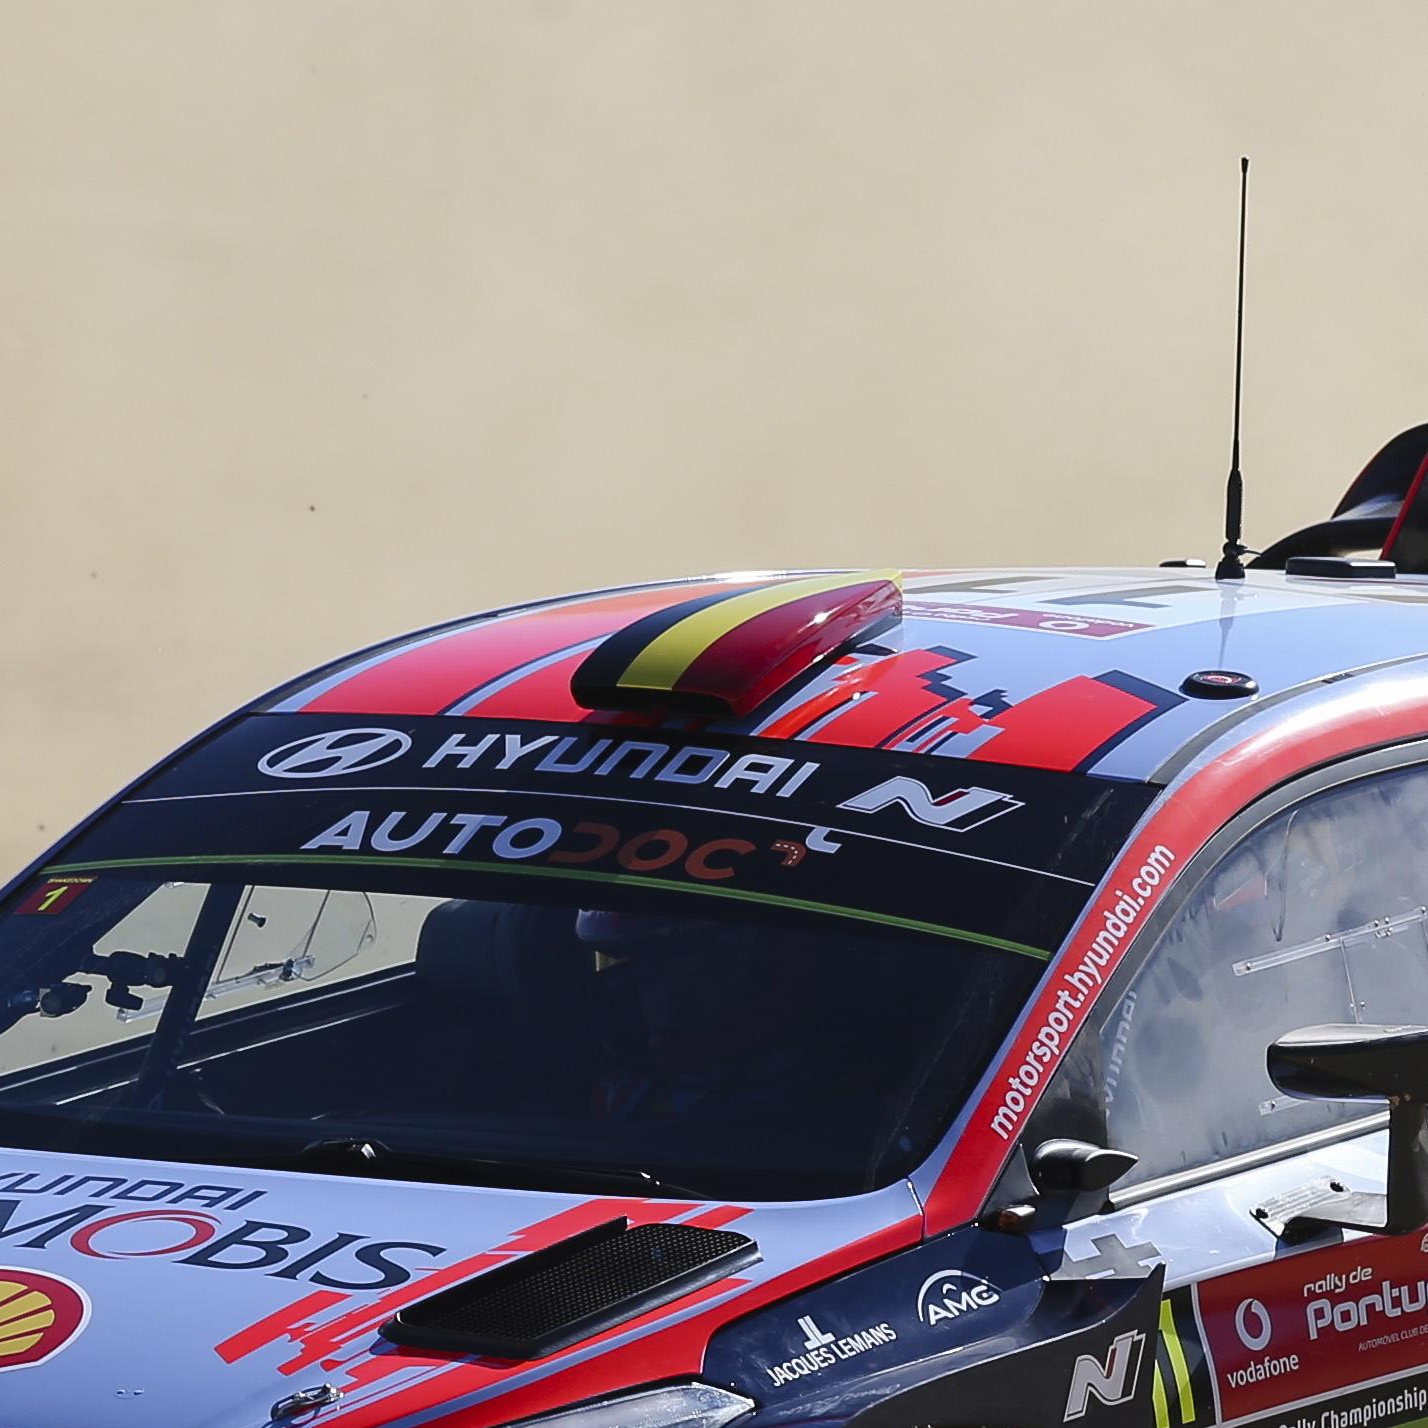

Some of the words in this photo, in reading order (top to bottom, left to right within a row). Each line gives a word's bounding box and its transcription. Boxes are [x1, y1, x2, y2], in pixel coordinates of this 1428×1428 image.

[423, 732, 820, 798] HYUNDAI
[300, 810, 757, 880] AUTODOC
[990, 844, 1176, 1140] motorsport.hyundai.com
[1303, 1269, 1345, 1297] rally
[1348, 1265, 1373, 1283] de
[766, 1347, 837, 1388] JACQUES
[832, 1322, 898, 1361] LEMANS
[1227, 1354, 1300, 1389] vodafone
